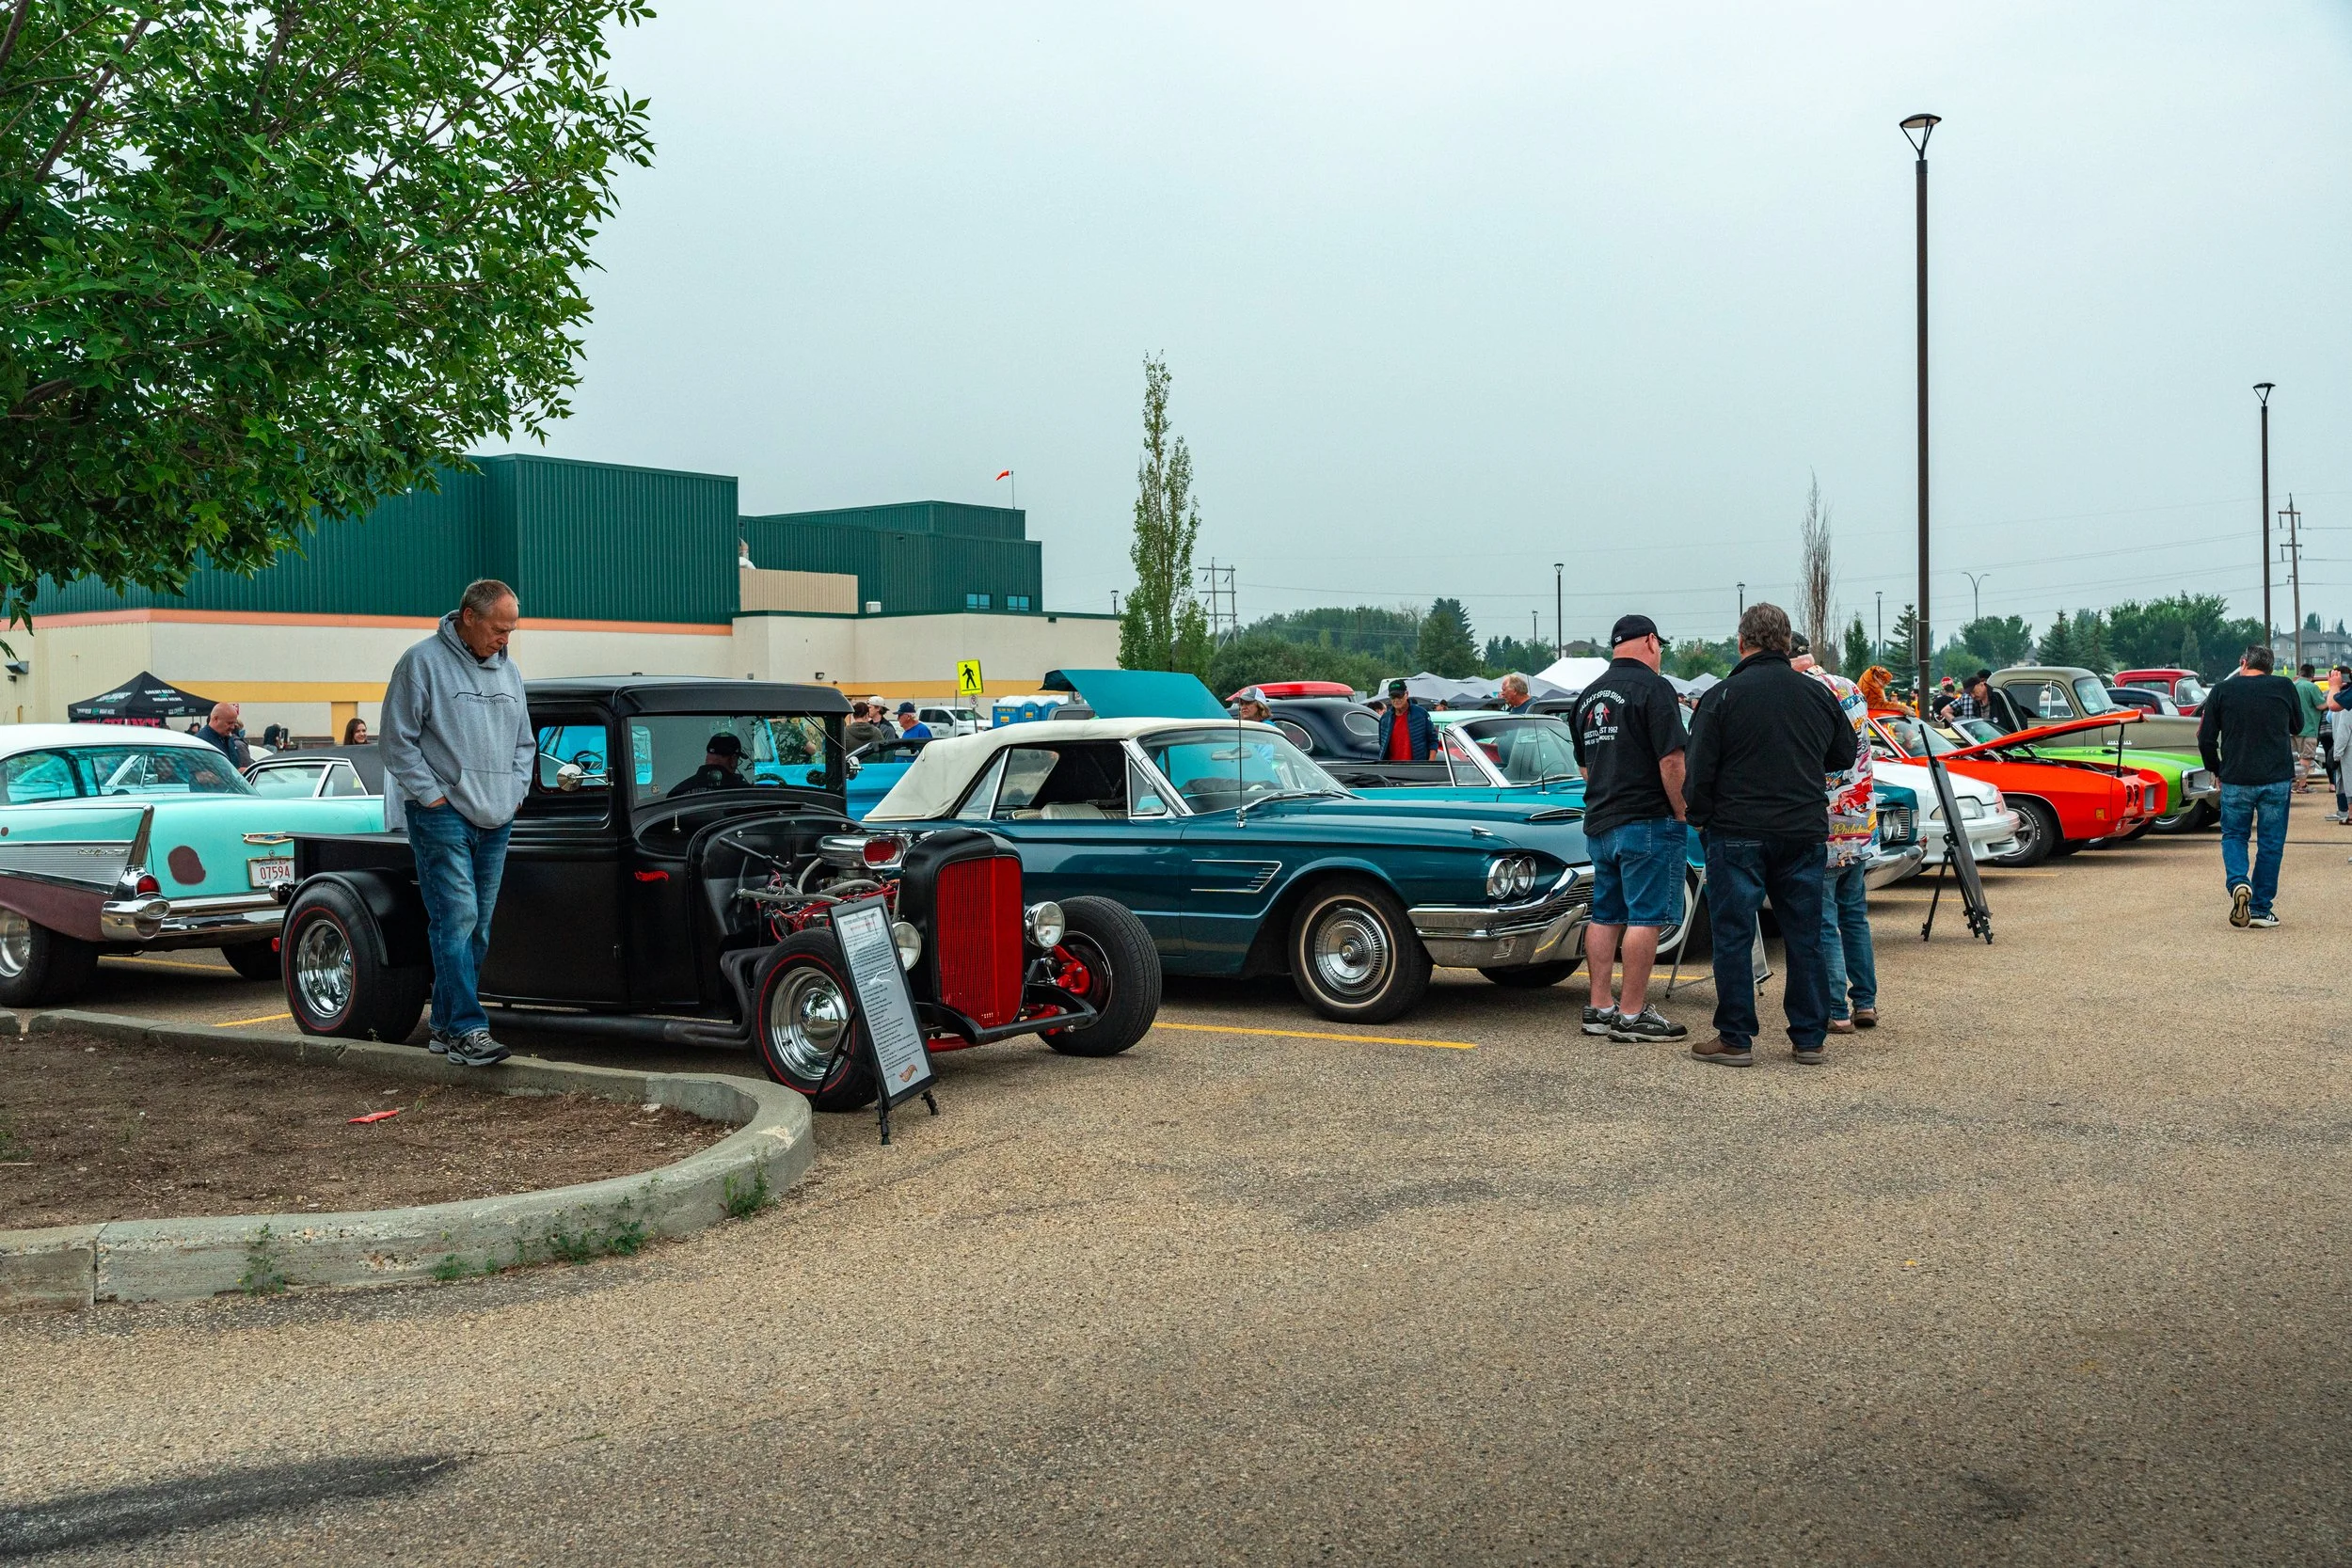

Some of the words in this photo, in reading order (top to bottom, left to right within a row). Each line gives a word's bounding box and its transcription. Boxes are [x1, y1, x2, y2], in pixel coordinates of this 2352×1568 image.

[1597, 689, 1611, 699] SPEED
[1610, 691, 1625, 705] SHOP
[260, 865, 291, 880] 07594
